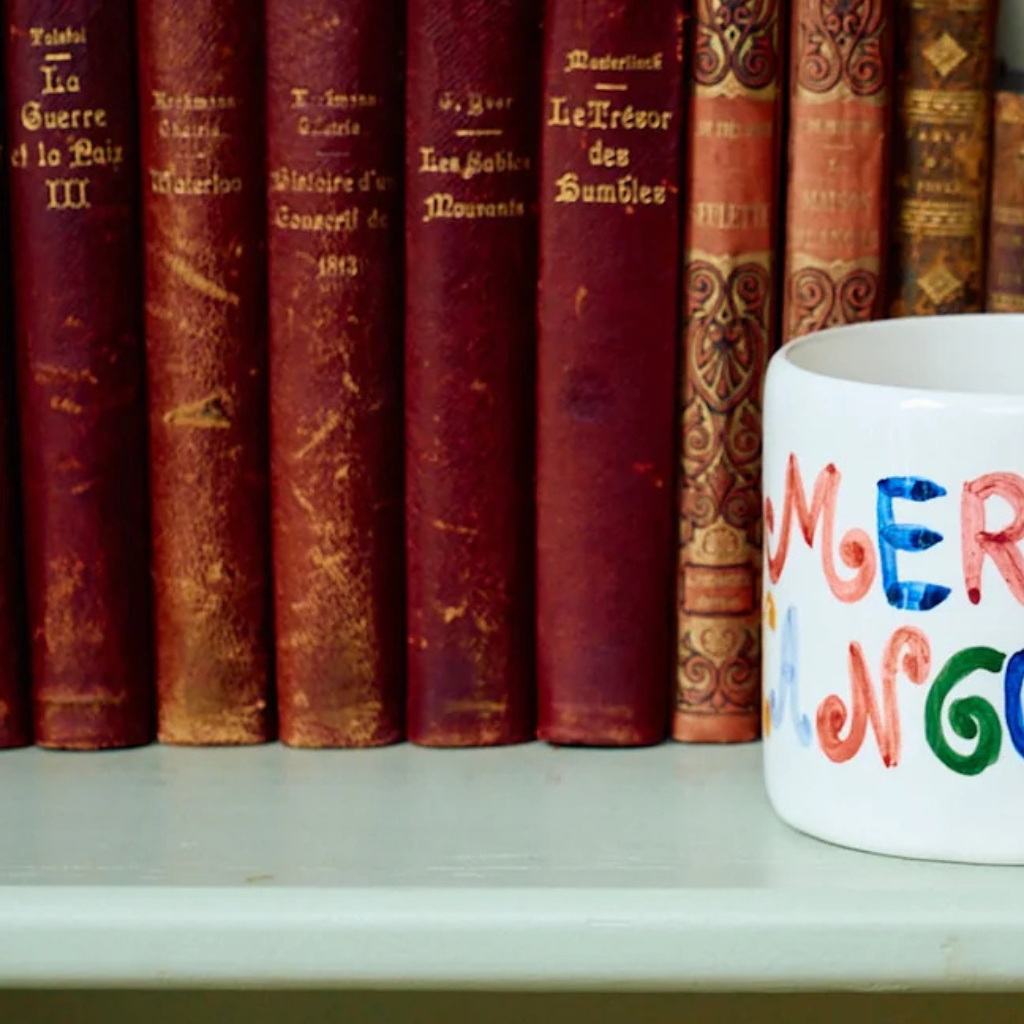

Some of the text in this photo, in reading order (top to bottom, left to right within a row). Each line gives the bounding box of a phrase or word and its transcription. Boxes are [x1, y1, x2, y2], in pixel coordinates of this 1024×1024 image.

[39, 64, 81, 95] La
[20, 100, 107, 131] Guerre
[546, 97, 586, 127] Le
[588, 139, 630, 167] des
[45, 178, 91, 209] III
[554, 172, 667, 205] Humbles
